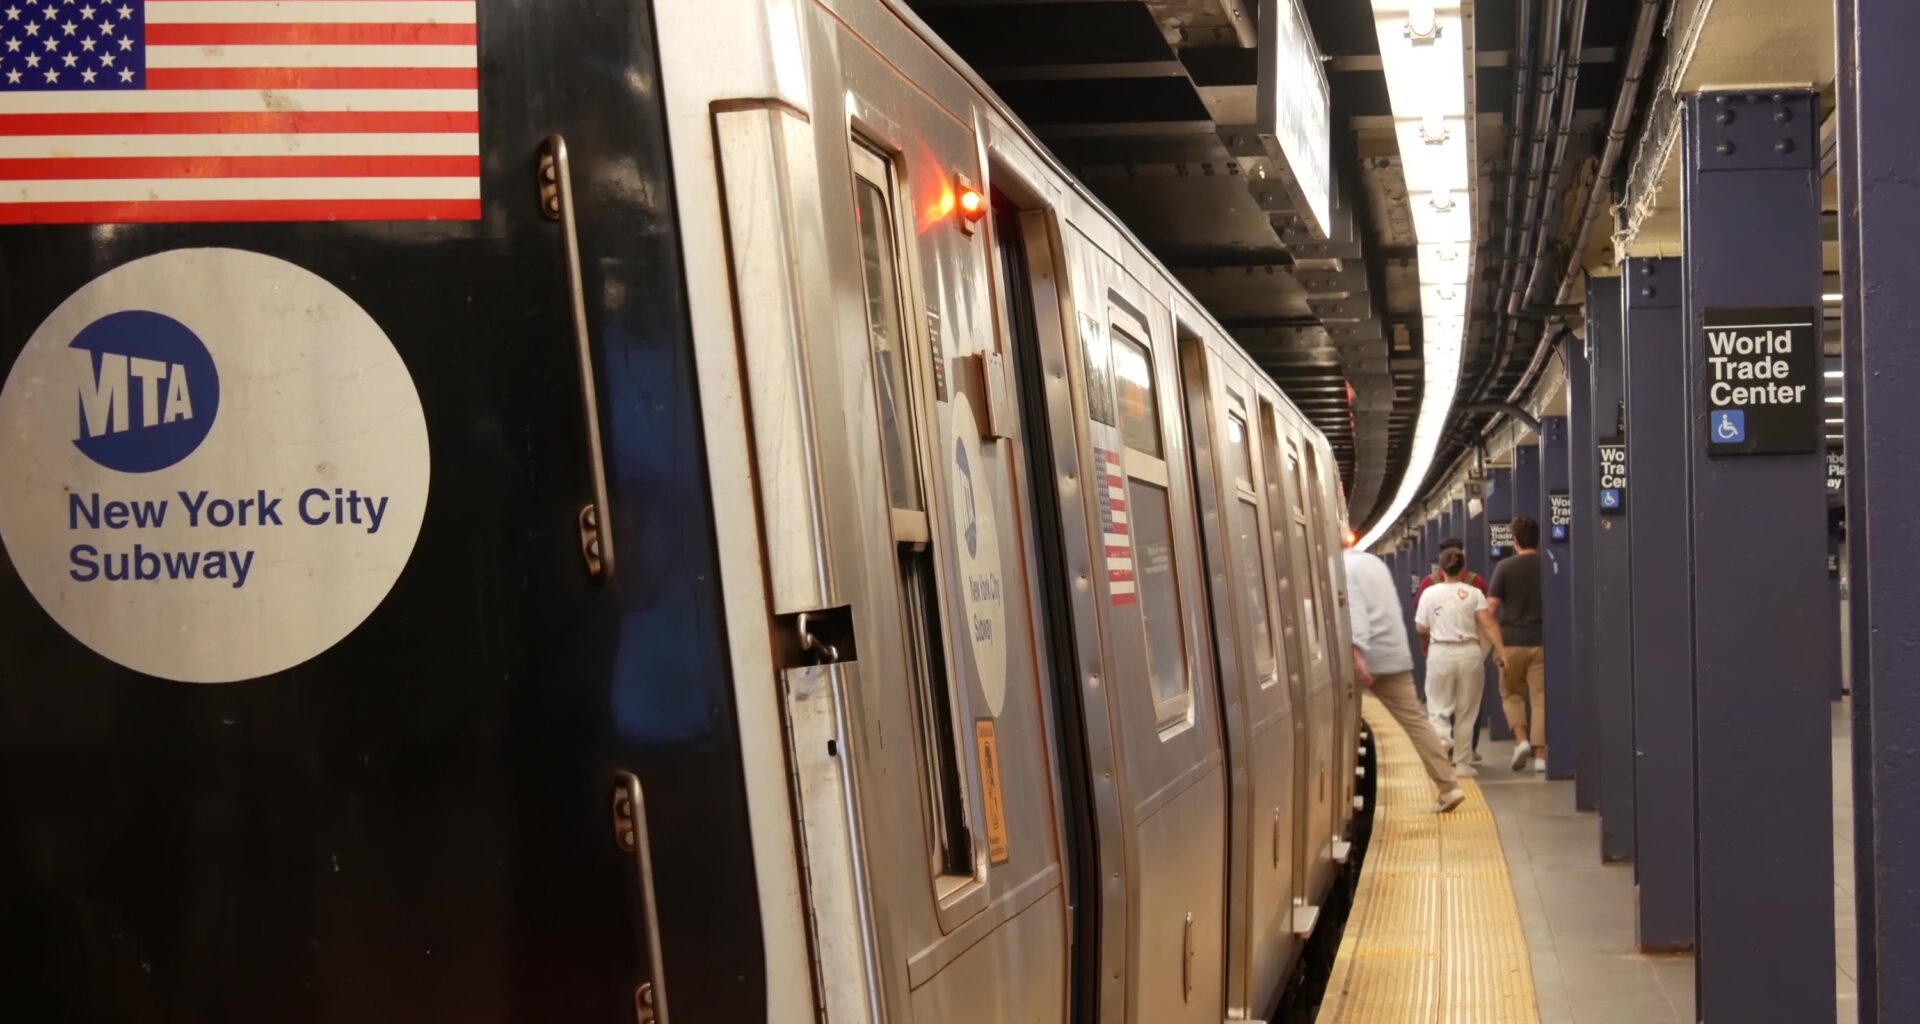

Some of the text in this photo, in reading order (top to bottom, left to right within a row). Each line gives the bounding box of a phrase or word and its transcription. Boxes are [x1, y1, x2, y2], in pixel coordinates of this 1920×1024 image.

[1708, 330, 1792, 355] World
[1708, 356, 1789, 380] Trade
[67, 347, 193, 440] MTA
[1710, 382, 1806, 406] Center
[69, 487, 389, 534] New York City
[69, 543, 255, 588] Subway
